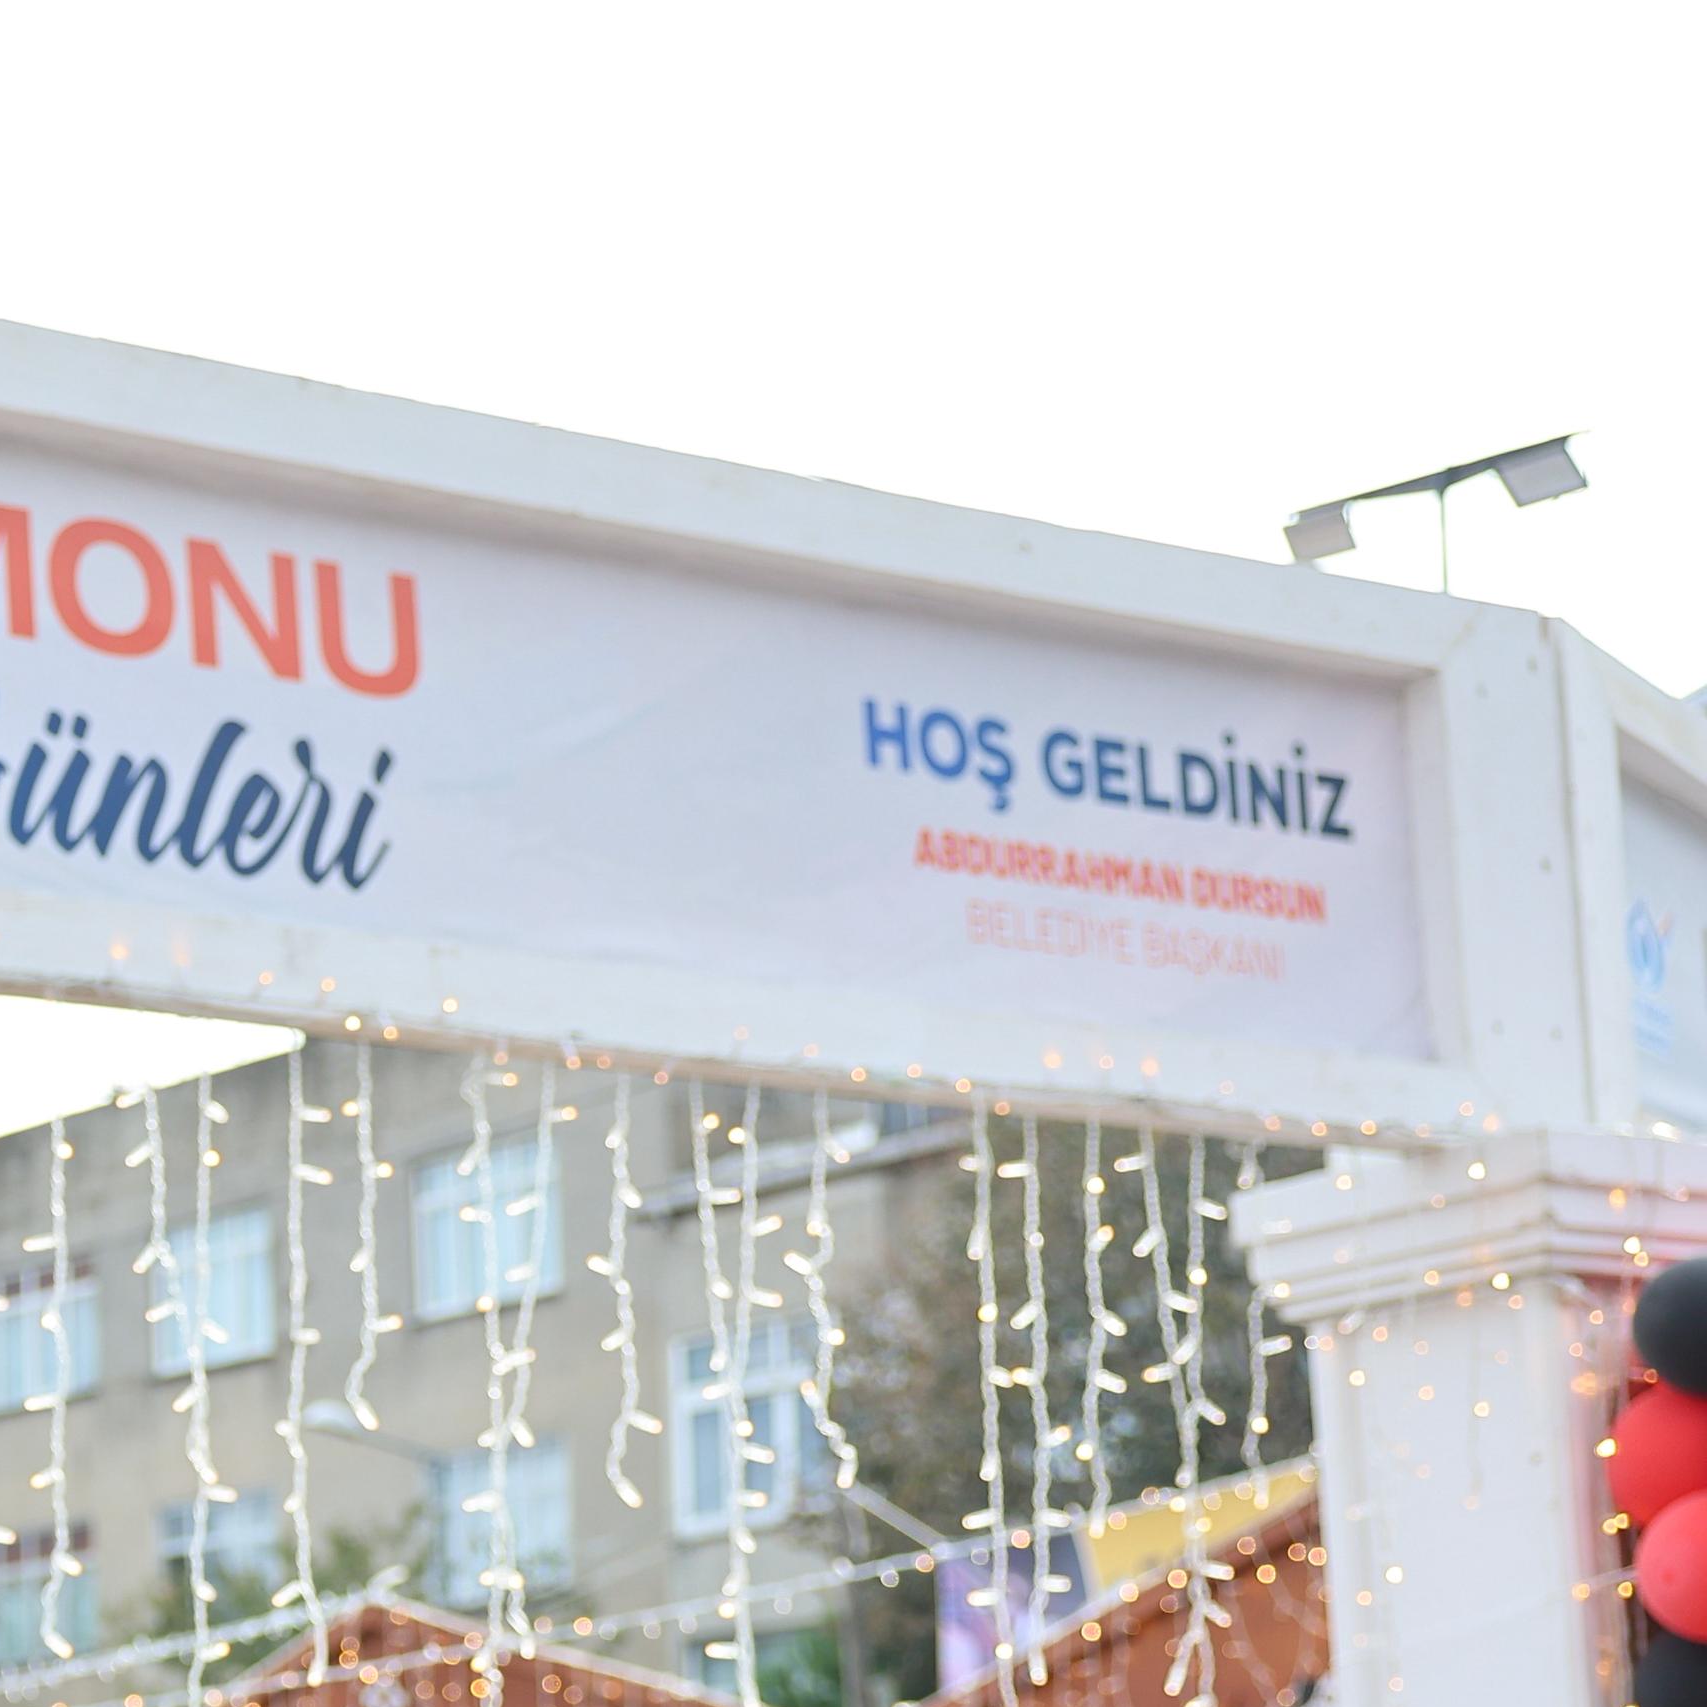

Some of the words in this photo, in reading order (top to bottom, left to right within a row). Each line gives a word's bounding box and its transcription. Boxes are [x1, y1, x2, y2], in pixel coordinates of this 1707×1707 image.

[862, 697, 1017, 814] HOŞ
[1041, 731, 1355, 841] GELDİNİZ
[913, 825, 1186, 905] ABDURRAHMAN
[1190, 865, 1328, 924] DURSUN
[1143, 923, 1284, 980] BAŞKANI
